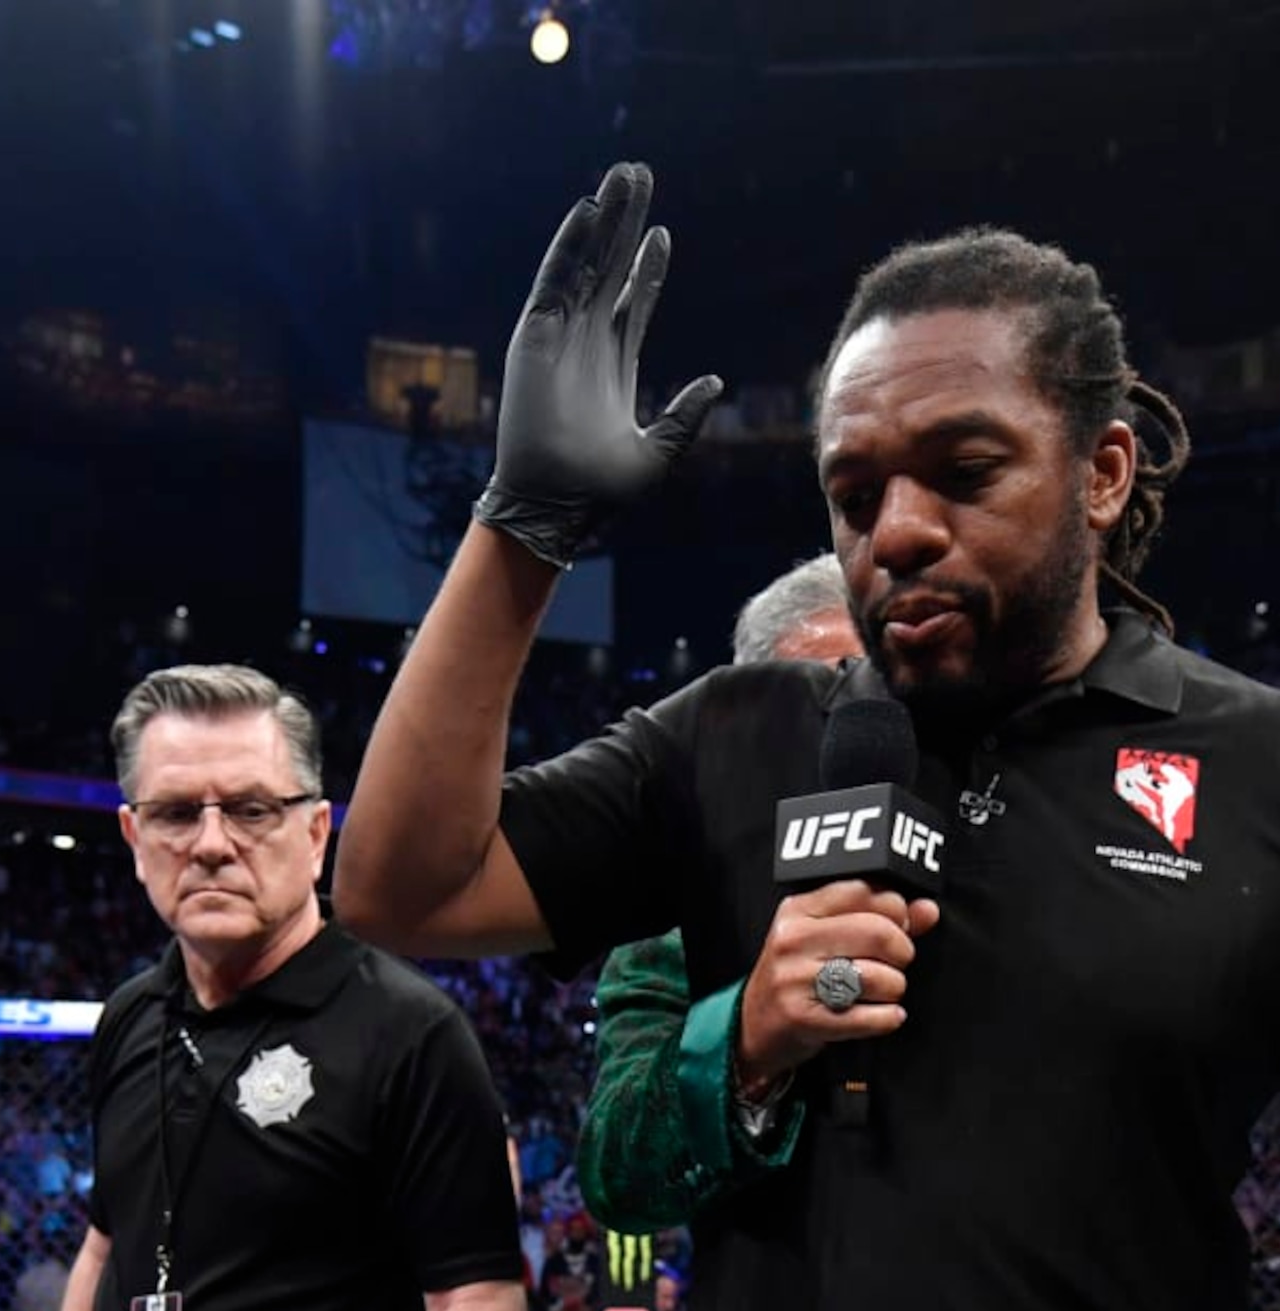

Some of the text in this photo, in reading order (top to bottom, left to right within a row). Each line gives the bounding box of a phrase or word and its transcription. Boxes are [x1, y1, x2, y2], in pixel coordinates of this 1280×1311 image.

[781, 806, 883, 861] UFC
[890, 811, 945, 872] UFC
[1094, 845, 1203, 873] NEVADA ATHLETIC
[1110, 857, 1187, 880] COMMISSION
